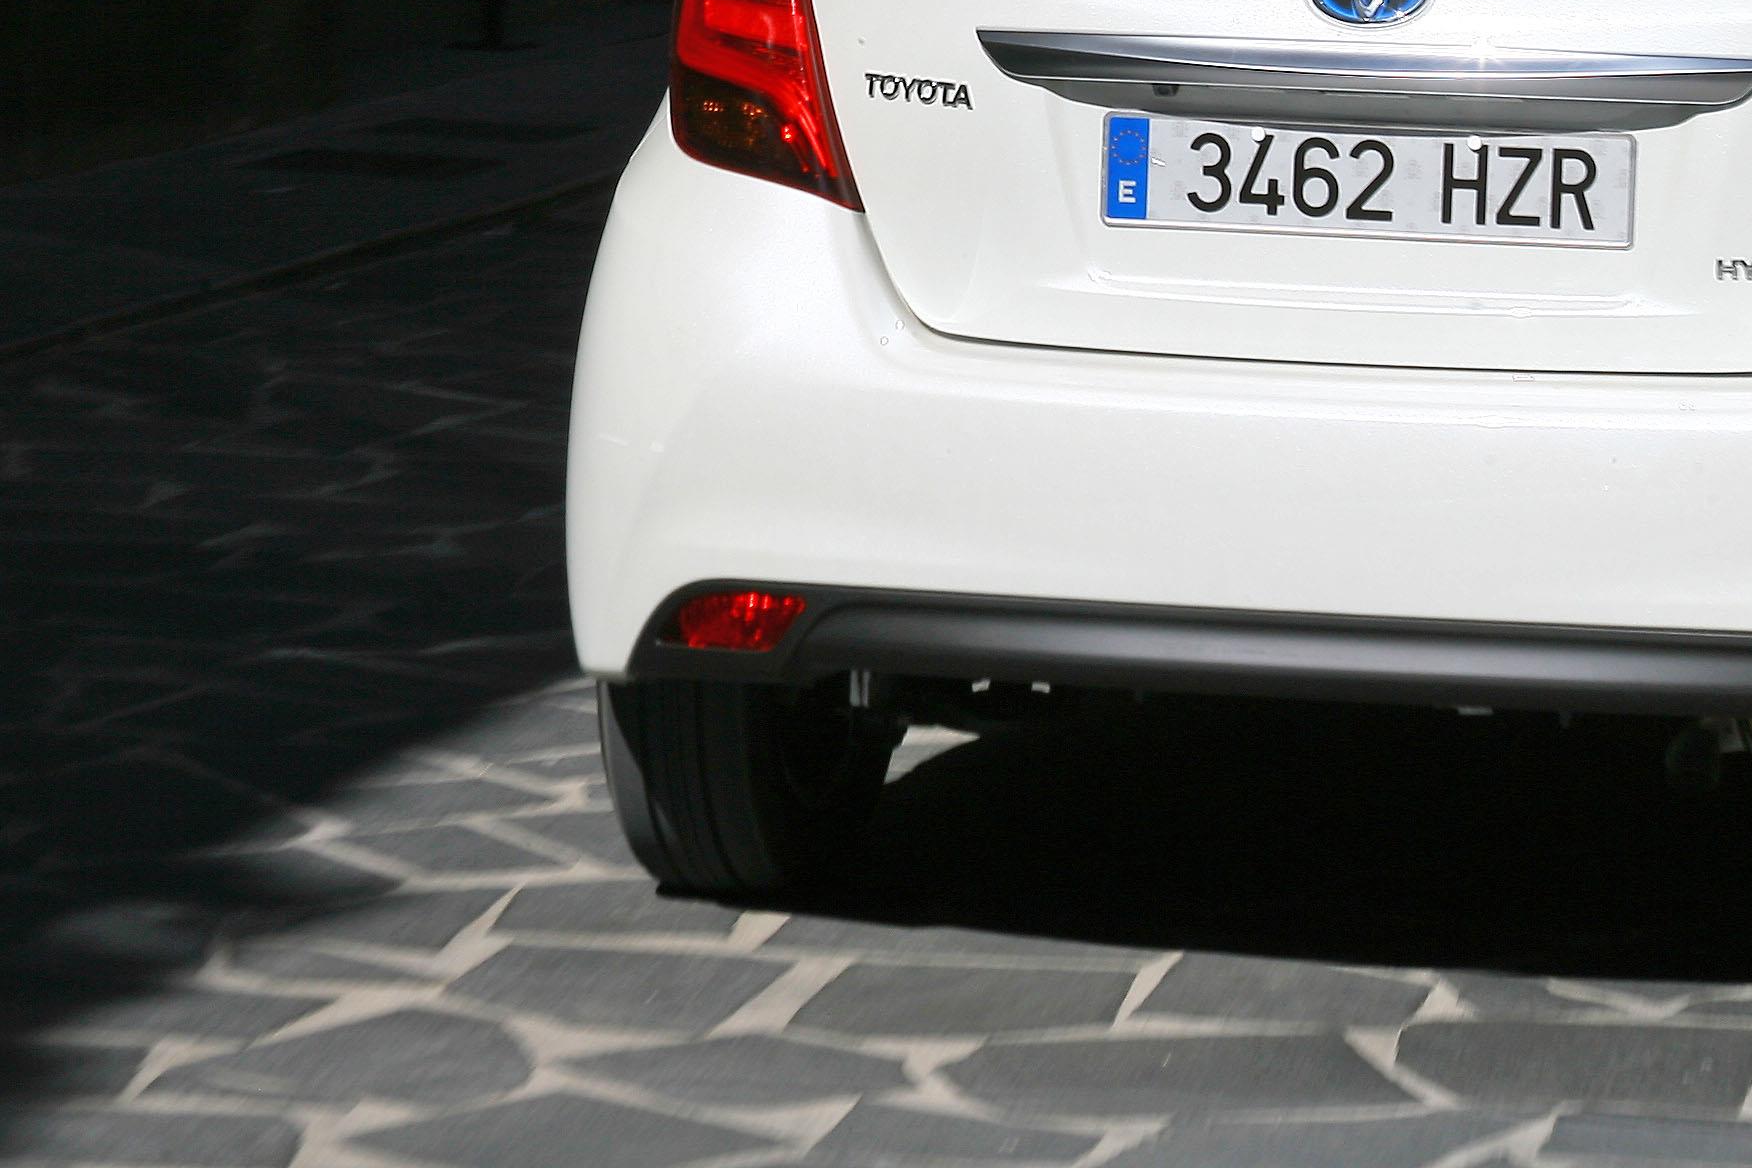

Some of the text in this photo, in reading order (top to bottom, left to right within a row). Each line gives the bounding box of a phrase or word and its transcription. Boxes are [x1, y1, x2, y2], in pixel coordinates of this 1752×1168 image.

[865, 73, 973, 111] TOYOTA
[1118, 179, 1136, 203] E
[1186, 131, 1598, 231] 3462 HZR
